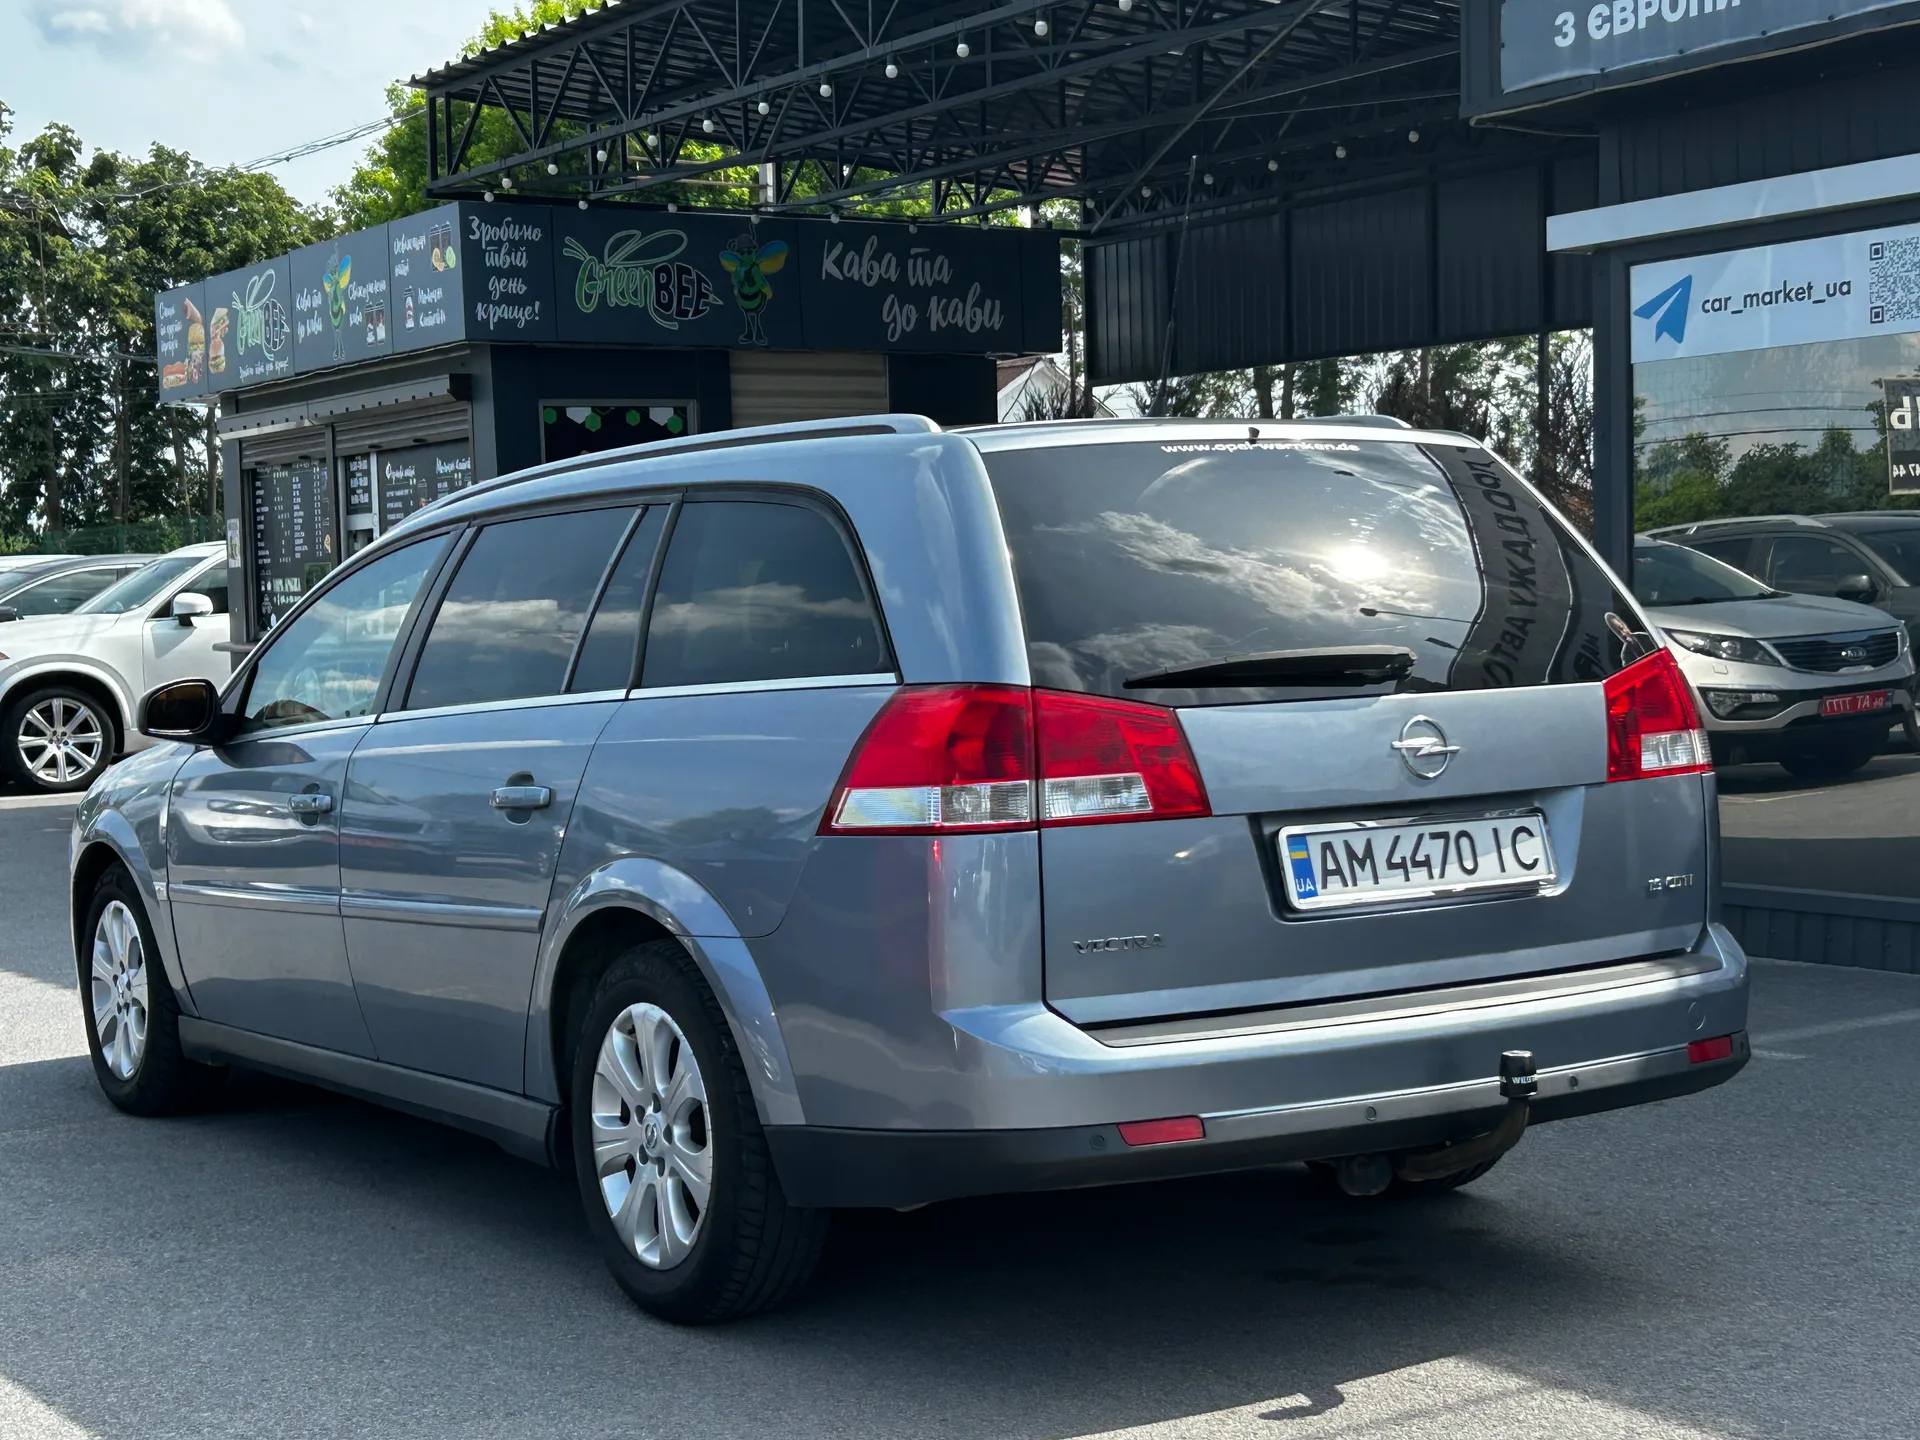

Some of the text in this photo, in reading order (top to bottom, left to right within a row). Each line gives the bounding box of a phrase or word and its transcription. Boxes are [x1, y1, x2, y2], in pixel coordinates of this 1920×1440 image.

[1587, 0, 1741, 40] ЄВРО
[468, 215, 542, 249] Зробимо
[485, 241, 528, 269] твій
[821, 235, 953, 287] Кава та
[488, 275, 527, 300] день
[1701, 279, 1852, 315] car_market_ua
[475, 301, 540, 331] краще!
[882, 282, 1004, 342] до кави
[1320, 825, 1540, 890] AM 4470 IC
[1295, 877, 1316, 893] UA
[1072, 932, 1166, 955] VECTRA
